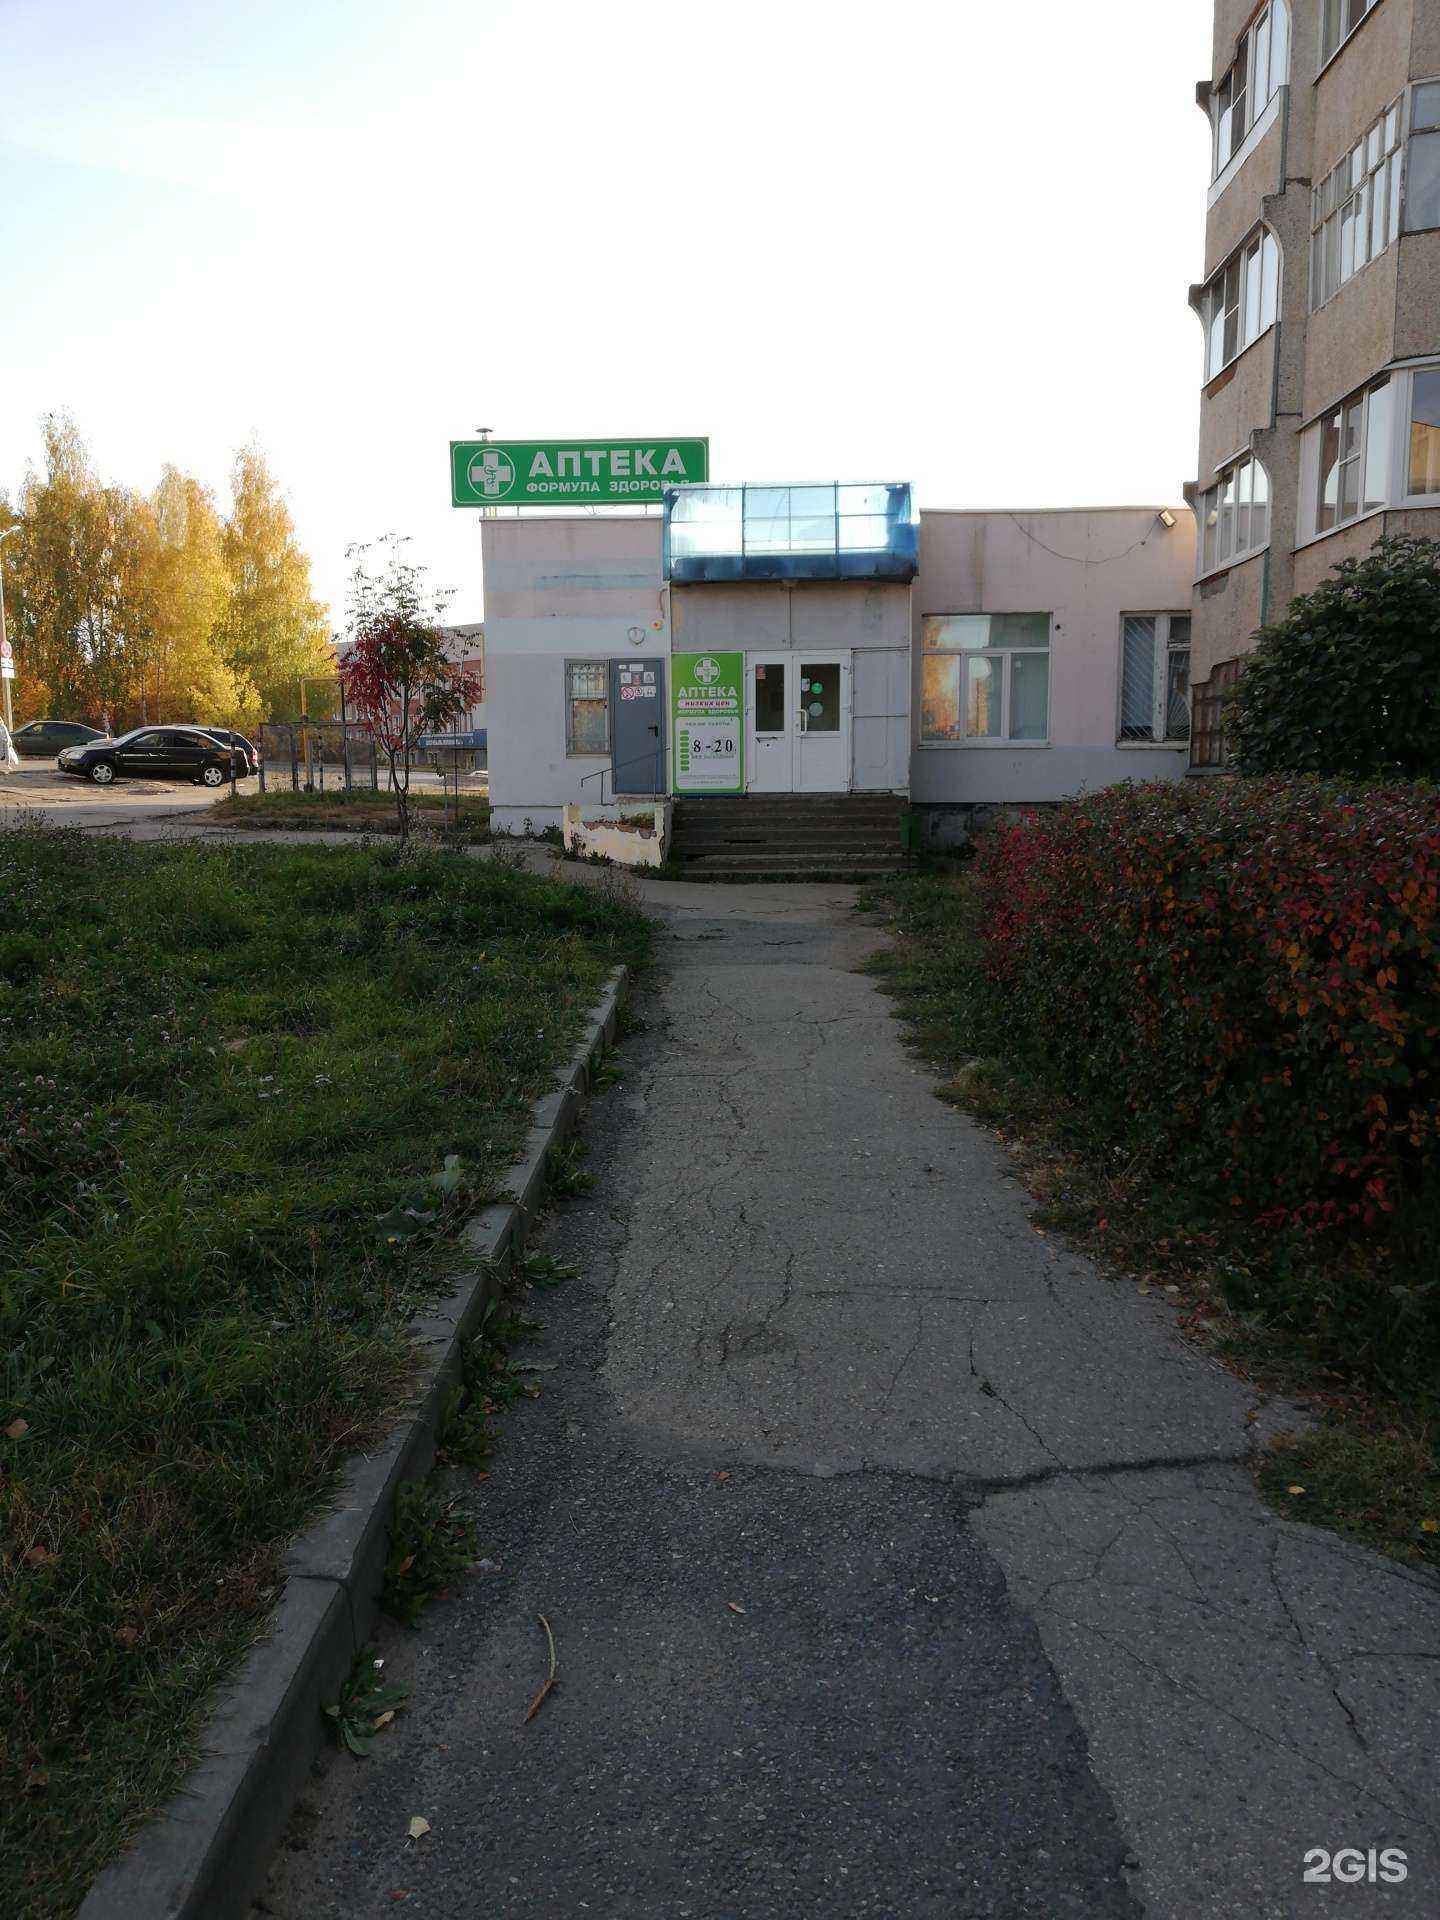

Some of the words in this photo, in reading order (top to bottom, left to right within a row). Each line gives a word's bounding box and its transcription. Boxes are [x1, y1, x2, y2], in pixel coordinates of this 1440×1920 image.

[528, 449, 687, 477] АПТЕКА
[526, 482, 601, 493] ФОРМУЛА
[679, 687, 737, 697] АПТЕКА
